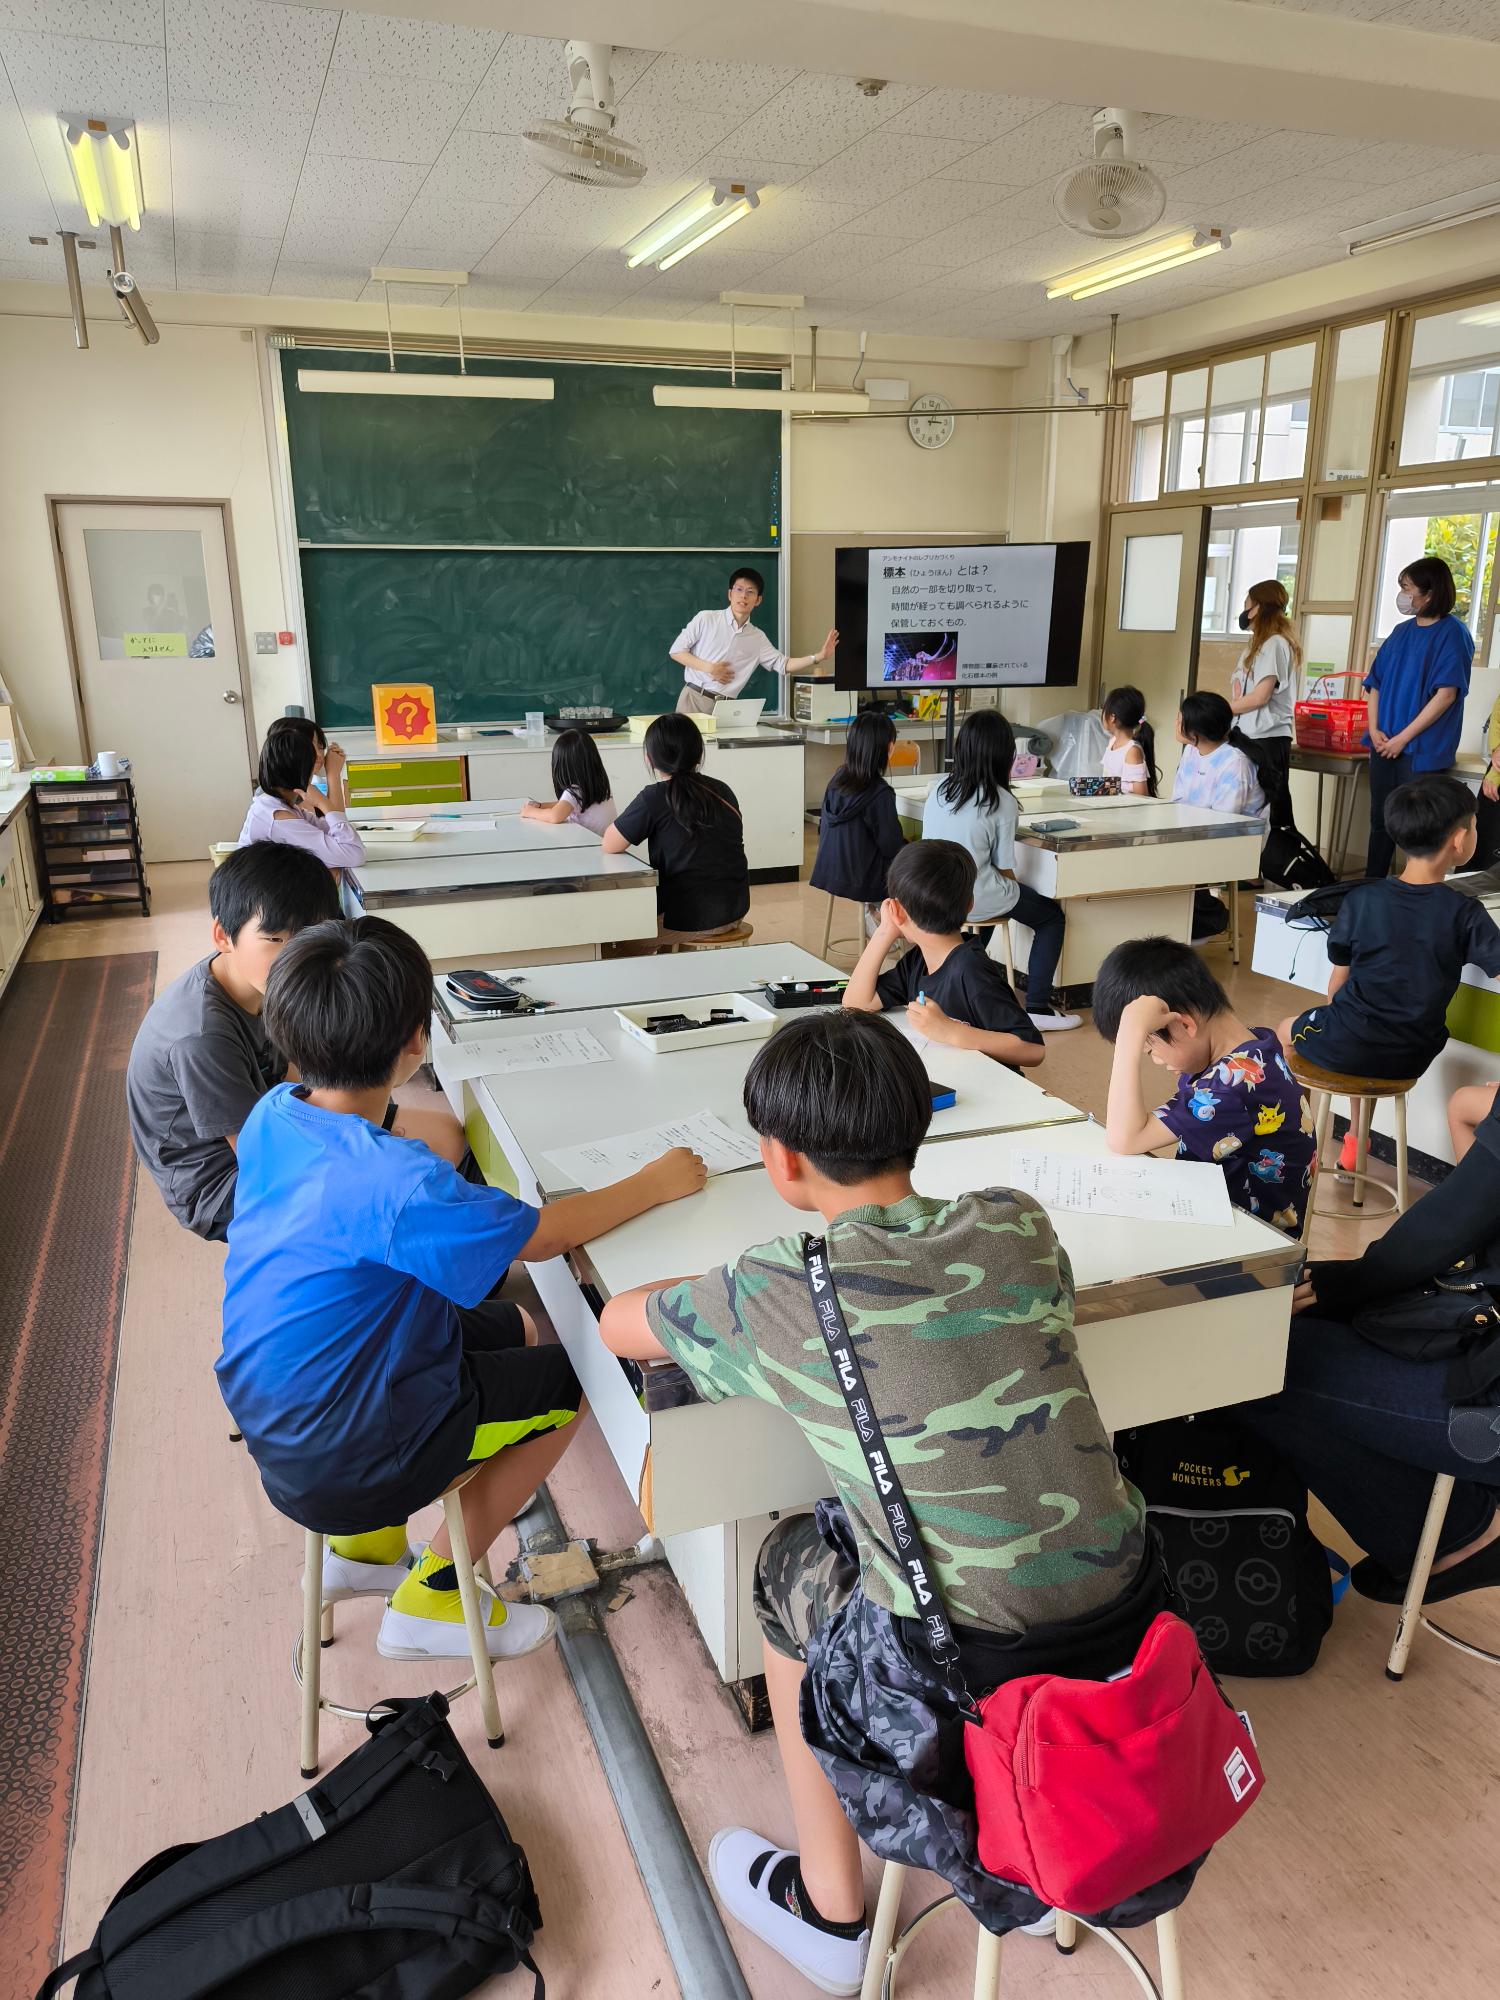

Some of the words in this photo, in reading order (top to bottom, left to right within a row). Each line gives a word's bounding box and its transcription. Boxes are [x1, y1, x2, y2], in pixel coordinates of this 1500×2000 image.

[891, 600, 1029, 611] 時間が経っても調べられるように
[808, 1254, 826, 1293] FILA
[818, 1299, 841, 1342] FILA
[834, 1348, 857, 1392] FILA
[851, 1398, 874, 1442] FILA
[869, 1450, 893, 1495] FILA
[1172, 1472, 1222, 1487] MONSTERS
[1179, 1461, 1213, 1475] POCKET
[888, 1503, 912, 1549] FILA
[907, 1558, 932, 1606] FILA
[927, 1614, 946, 1650] FIL
